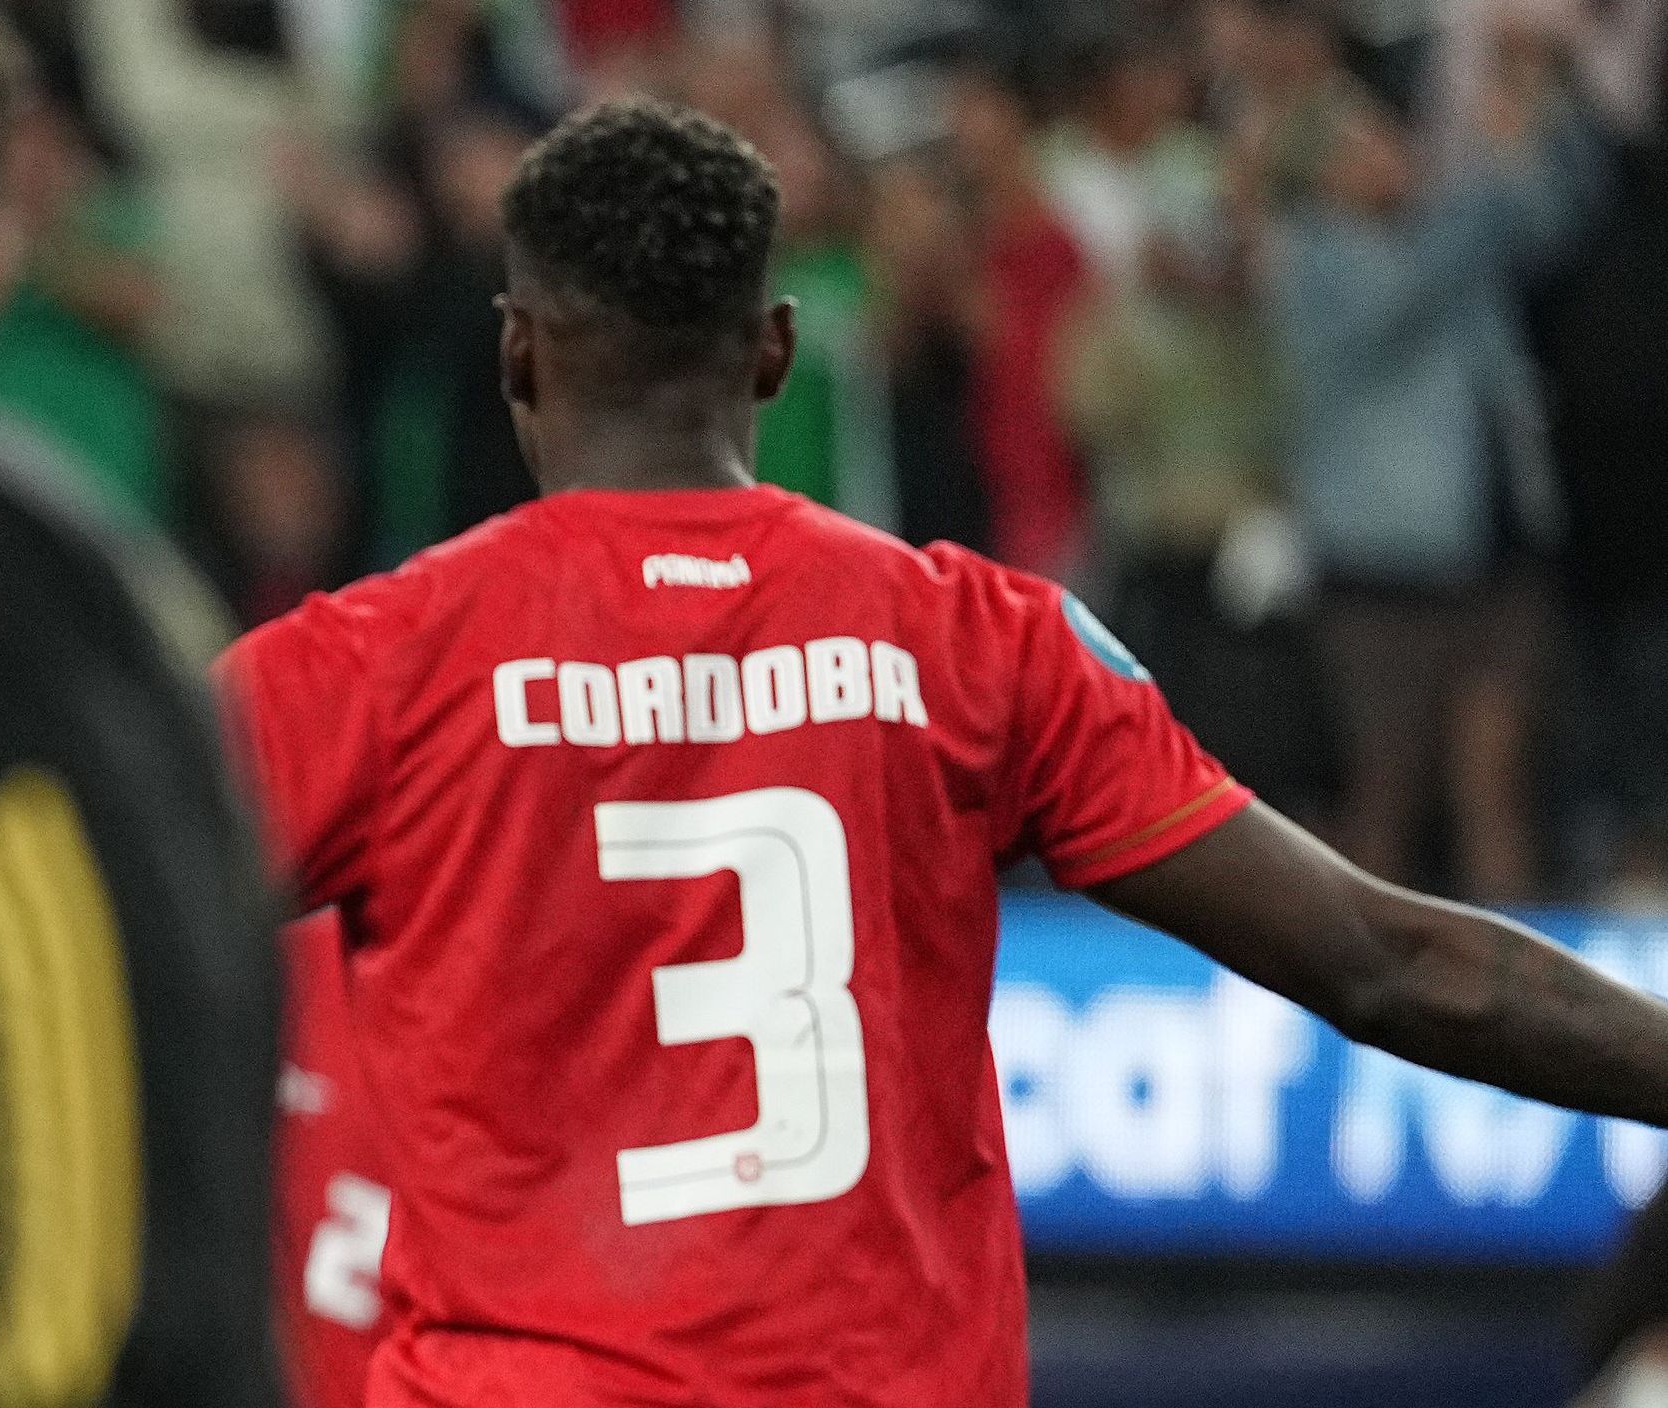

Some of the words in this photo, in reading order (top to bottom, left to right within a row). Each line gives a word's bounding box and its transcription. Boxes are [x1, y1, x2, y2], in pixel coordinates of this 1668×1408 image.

[493, 635, 930, 748] CORDOBA
[594, 785, 870, 1228] 3
[302, 1168, 392, 1333] 2
